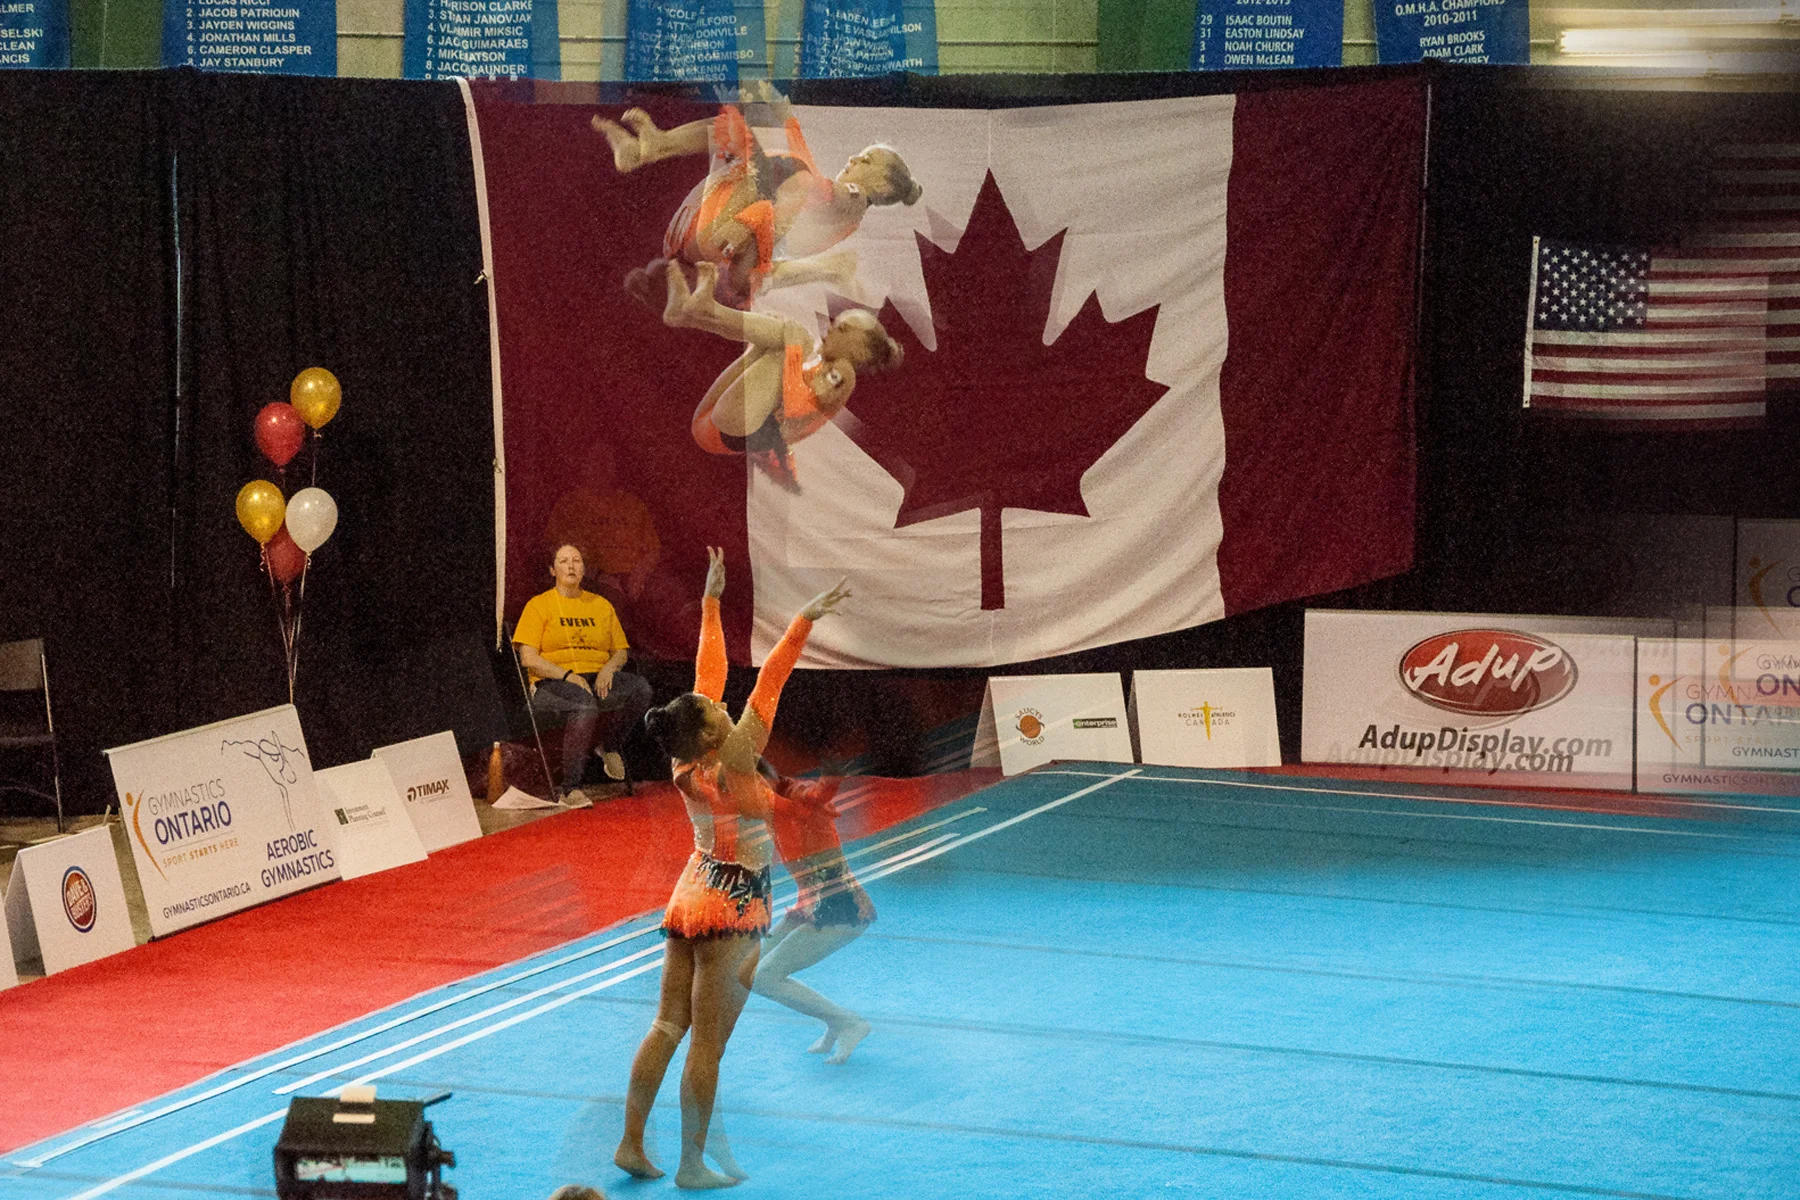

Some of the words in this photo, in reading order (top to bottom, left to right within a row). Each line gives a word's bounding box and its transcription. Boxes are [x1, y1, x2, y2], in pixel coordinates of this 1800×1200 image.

[0, 3, 35, 13] LMER
[199, 8, 238, 18] JACOB
[241, 8, 300, 18] PATRIQUIN
[1395, 2, 1439, 16] O.M.H.A.
[1442, 0, 1505, 11] CHAMPIONS
[1200, 14, 1213, 25] 29
[1225, 15, 1254, 25] ISAAC
[1256, 15, 1292, 26] BOUTIN
[1424, 10, 1477, 27] 2010-2011
[199, 21, 244, 31] JAYDEN
[246, 21, 295, 31] WIGGINS
[485, 26, 523, 37] MIKSIC
[199, 33, 260, 42] JONATHAN
[263, 33, 296, 42] MILLS
[1200, 28, 1211, 39] 31
[1225, 28, 1262, 38] EASTON
[1265, 28, 1305, 39] LINDSAY
[1420, 36, 1445, 47] RYAN
[1447, 30, 1485, 44] BROOKS
[200, 45, 257, 55] CAMERON
[260, 46, 312, 55] CLASPER
[461, 39, 529, 50] GUIMARAES
[1200, 41, 1206, 51] 3
[1224, 41, 1252, 51] NOAH
[1255, 41, 1294, 52] CHURCH
[1422, 47, 1451, 58] ADAM
[1453, 44, 1484, 56] CLARK
[0, 53, 30, 64] NCIS
[200, 58, 221, 67] JAY
[224, 58, 285, 67] STANBURY
[1199, 54, 1205, 64] 4
[1224, 54, 1253, 65] OWEN
[1256, 54, 1294, 65] McLEAN
[560, 617, 595, 627] EVENT
[1406, 642, 1566, 692] Adup
[1074, 718, 1117, 728] enterprise
[1020, 735, 1045, 746] WORLD
[1358, 724, 1613, 759] AdupDisplay.com
[416, 779, 450, 797] TIMAX
[148, 778, 225, 816] GYMNASTICS
[155, 801, 232, 845] ONTARIO
[266, 829, 318, 861] AEROBIC
[163, 852, 187, 869] SPORT
[189, 844, 218, 860] STARTS
[219, 837, 240, 851] HERE
[261, 849, 335, 888] GYMNASTICS
[163, 882, 251, 919] GYMNASTICSONTARIO.CA
